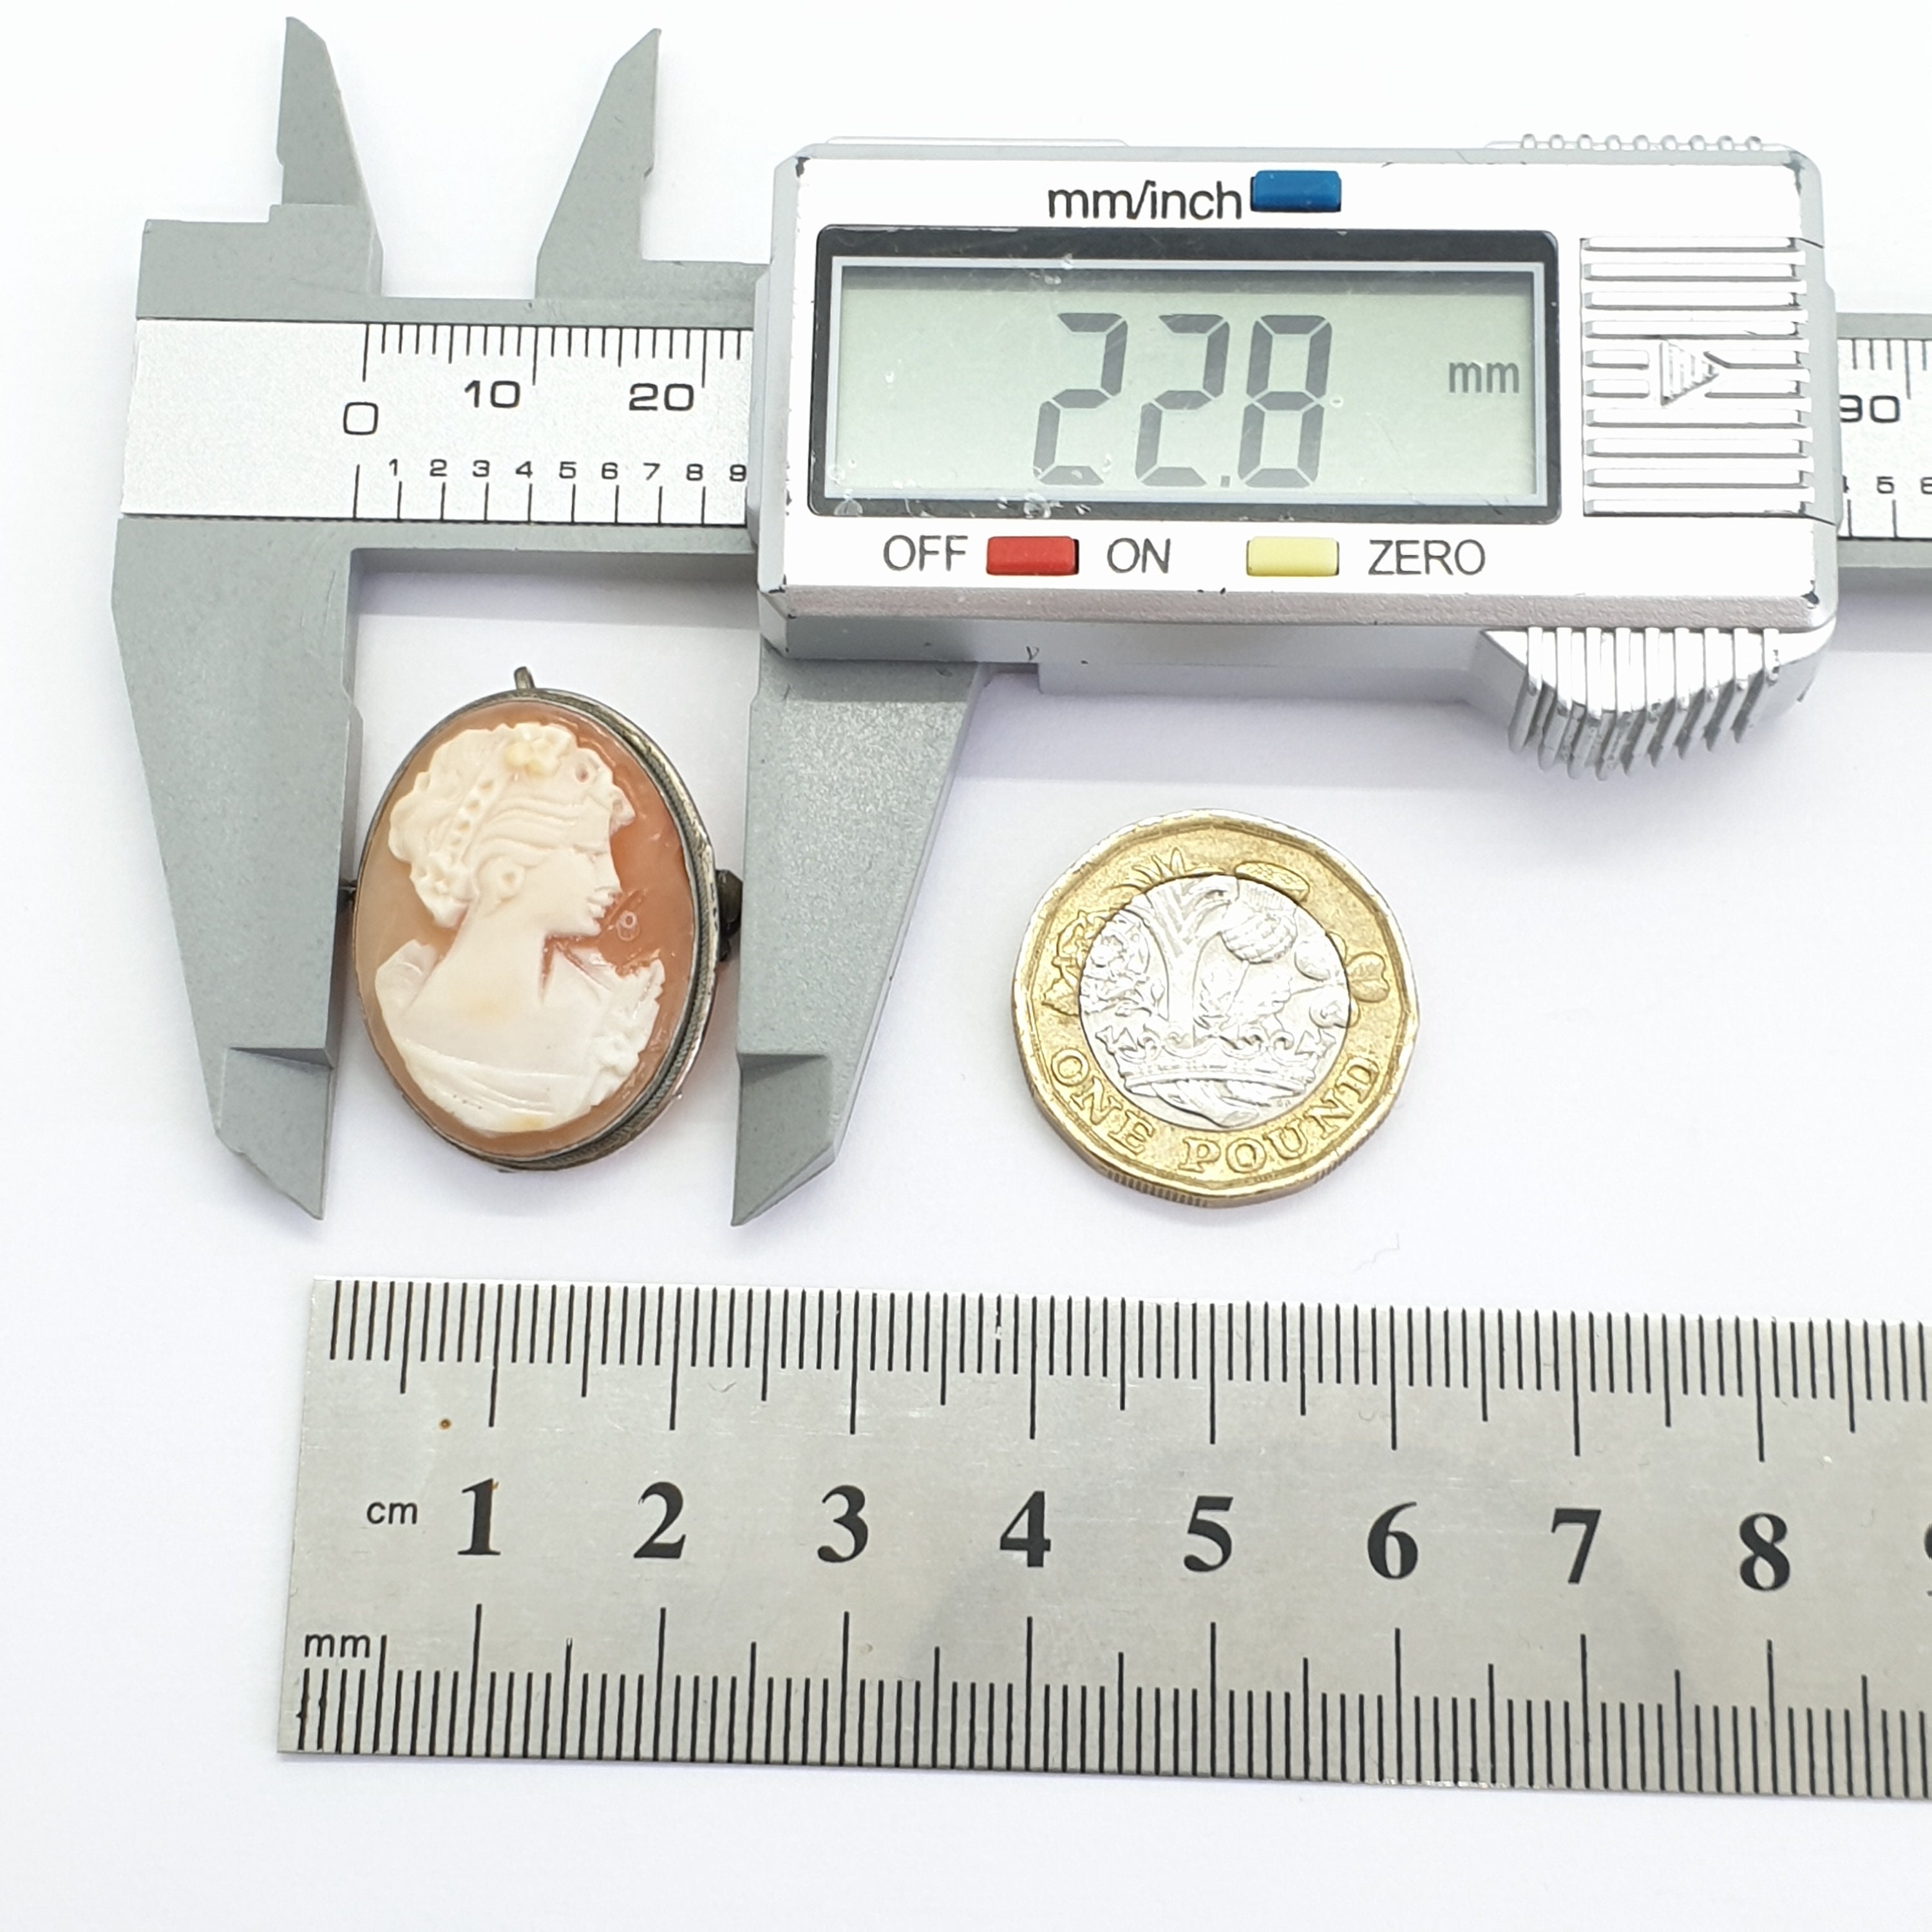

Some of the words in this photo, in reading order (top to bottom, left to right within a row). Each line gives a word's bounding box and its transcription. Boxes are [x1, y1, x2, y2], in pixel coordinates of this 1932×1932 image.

[1047, 179, 1243, 221] mm/inch
[1448, 360, 1520, 394] mm
[464, 379, 521, 409] 10
[629, 383, 694, 412] 20
[1032, 312, 1334, 488] 22.8
[1839, 394, 1901, 424] 90
[343, 401, 379, 436] 0
[388, 459, 399, 477] 1
[429, 459, 448, 477] 2
[471, 460, 491, 478] 3
[515, 460, 533, 478] 4
[558, 461, 577, 479] 5
[600, 462, 619, 480] 6
[643, 462, 661, 480] 7
[685, 463, 704, 482] 8
[728, 464, 748, 482] 9
[1876, 475, 1895, 495] 5
[883, 534, 969, 573] OFF
[1106, 537, 1172, 574] ON
[1367, 538, 1486, 576] ZERO
[1049, 1048, 1157, 1157] ONE
[1179, 1054, 1381, 1175] POUND
[366, 1501, 418, 1525] cm
[457, 1478, 501, 1556] 1
[633, 1481, 687, 1560] 2
[817, 1484, 869, 1564] 3
[999, 1490, 1052, 1568] 4
[1183, 1495, 1234, 1573] 5
[1367, 1501, 1419, 1580] 6
[1551, 1508, 1602, 1585] 7
[1739, 1513, 1791, 1591] 8
[303, 1633, 372, 1658] mm
